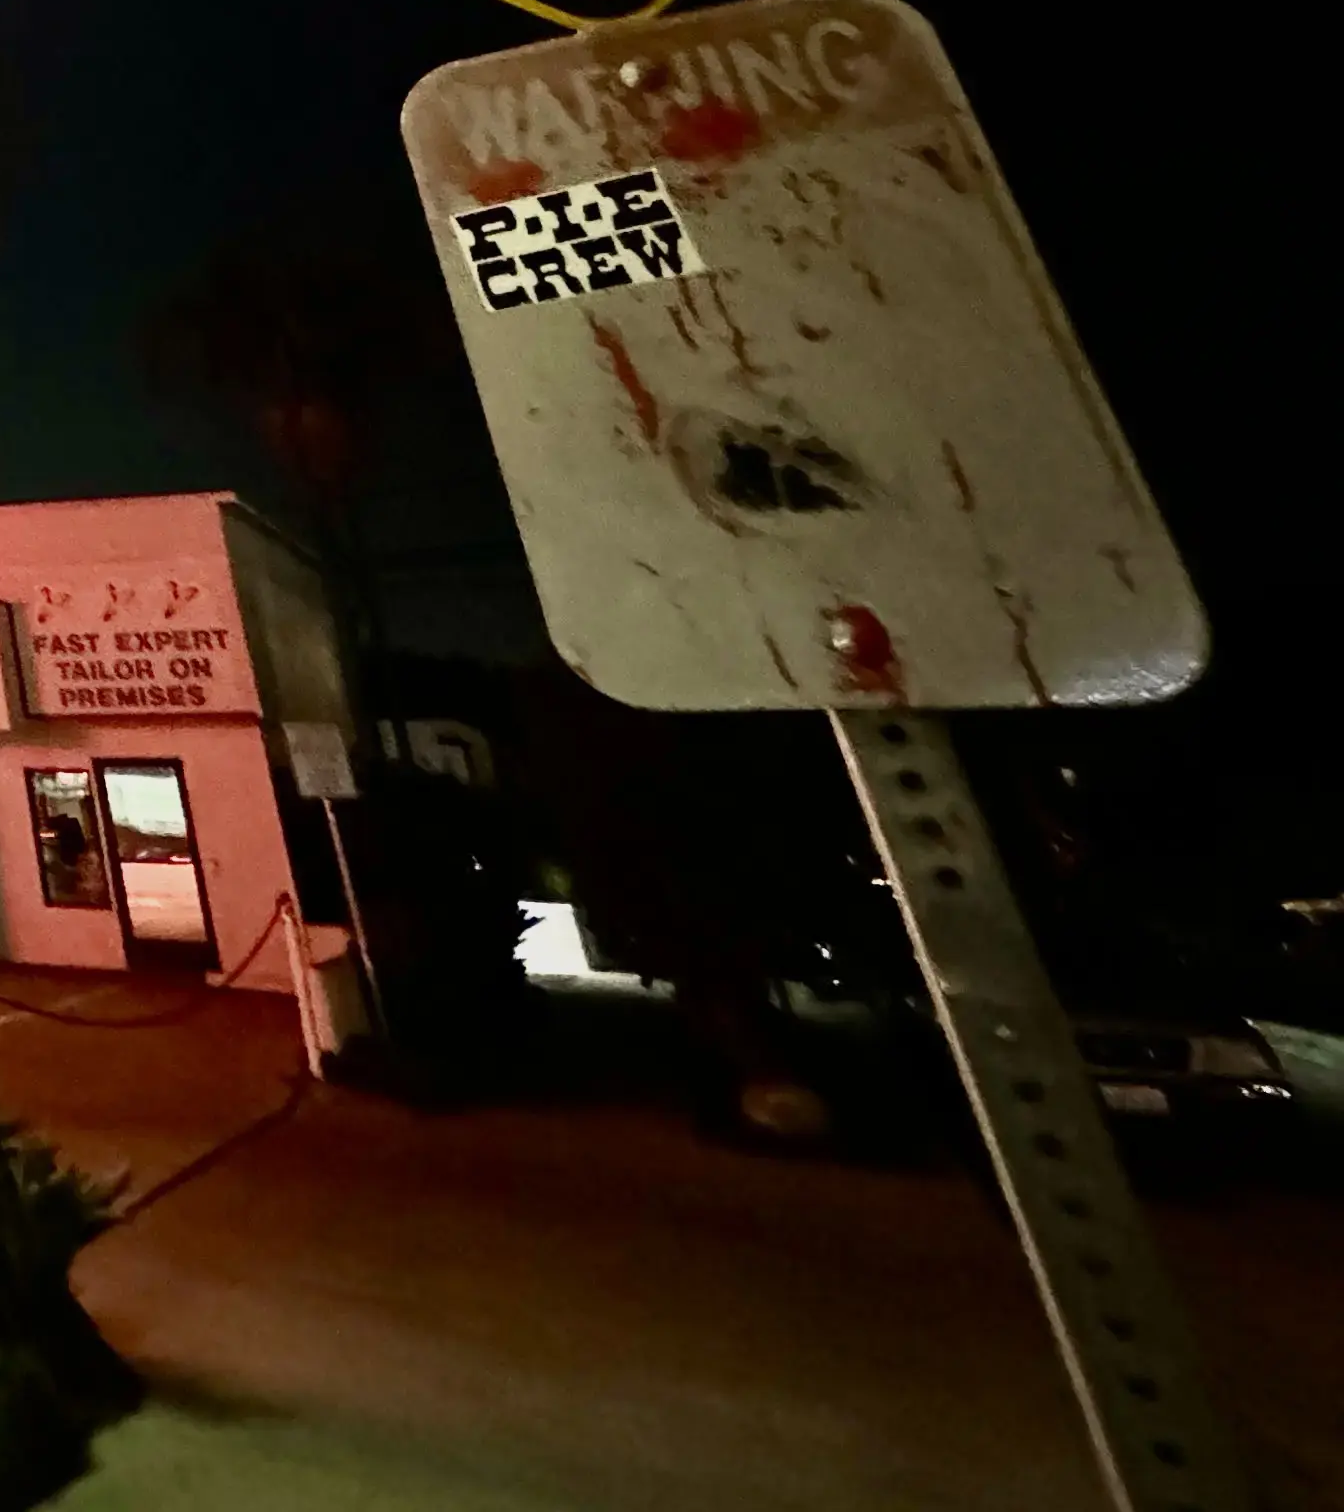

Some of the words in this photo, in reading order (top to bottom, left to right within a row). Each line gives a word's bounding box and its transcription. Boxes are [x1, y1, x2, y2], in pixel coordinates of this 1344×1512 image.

[476, 221, 684, 312] CREW
[33, 632, 100, 655] FAST
[113, 628, 229, 653] EXPERT
[55, 659, 155, 682] TAILOR
[168, 657, 214, 680] ON
[58, 684, 206, 708] PREMISES
